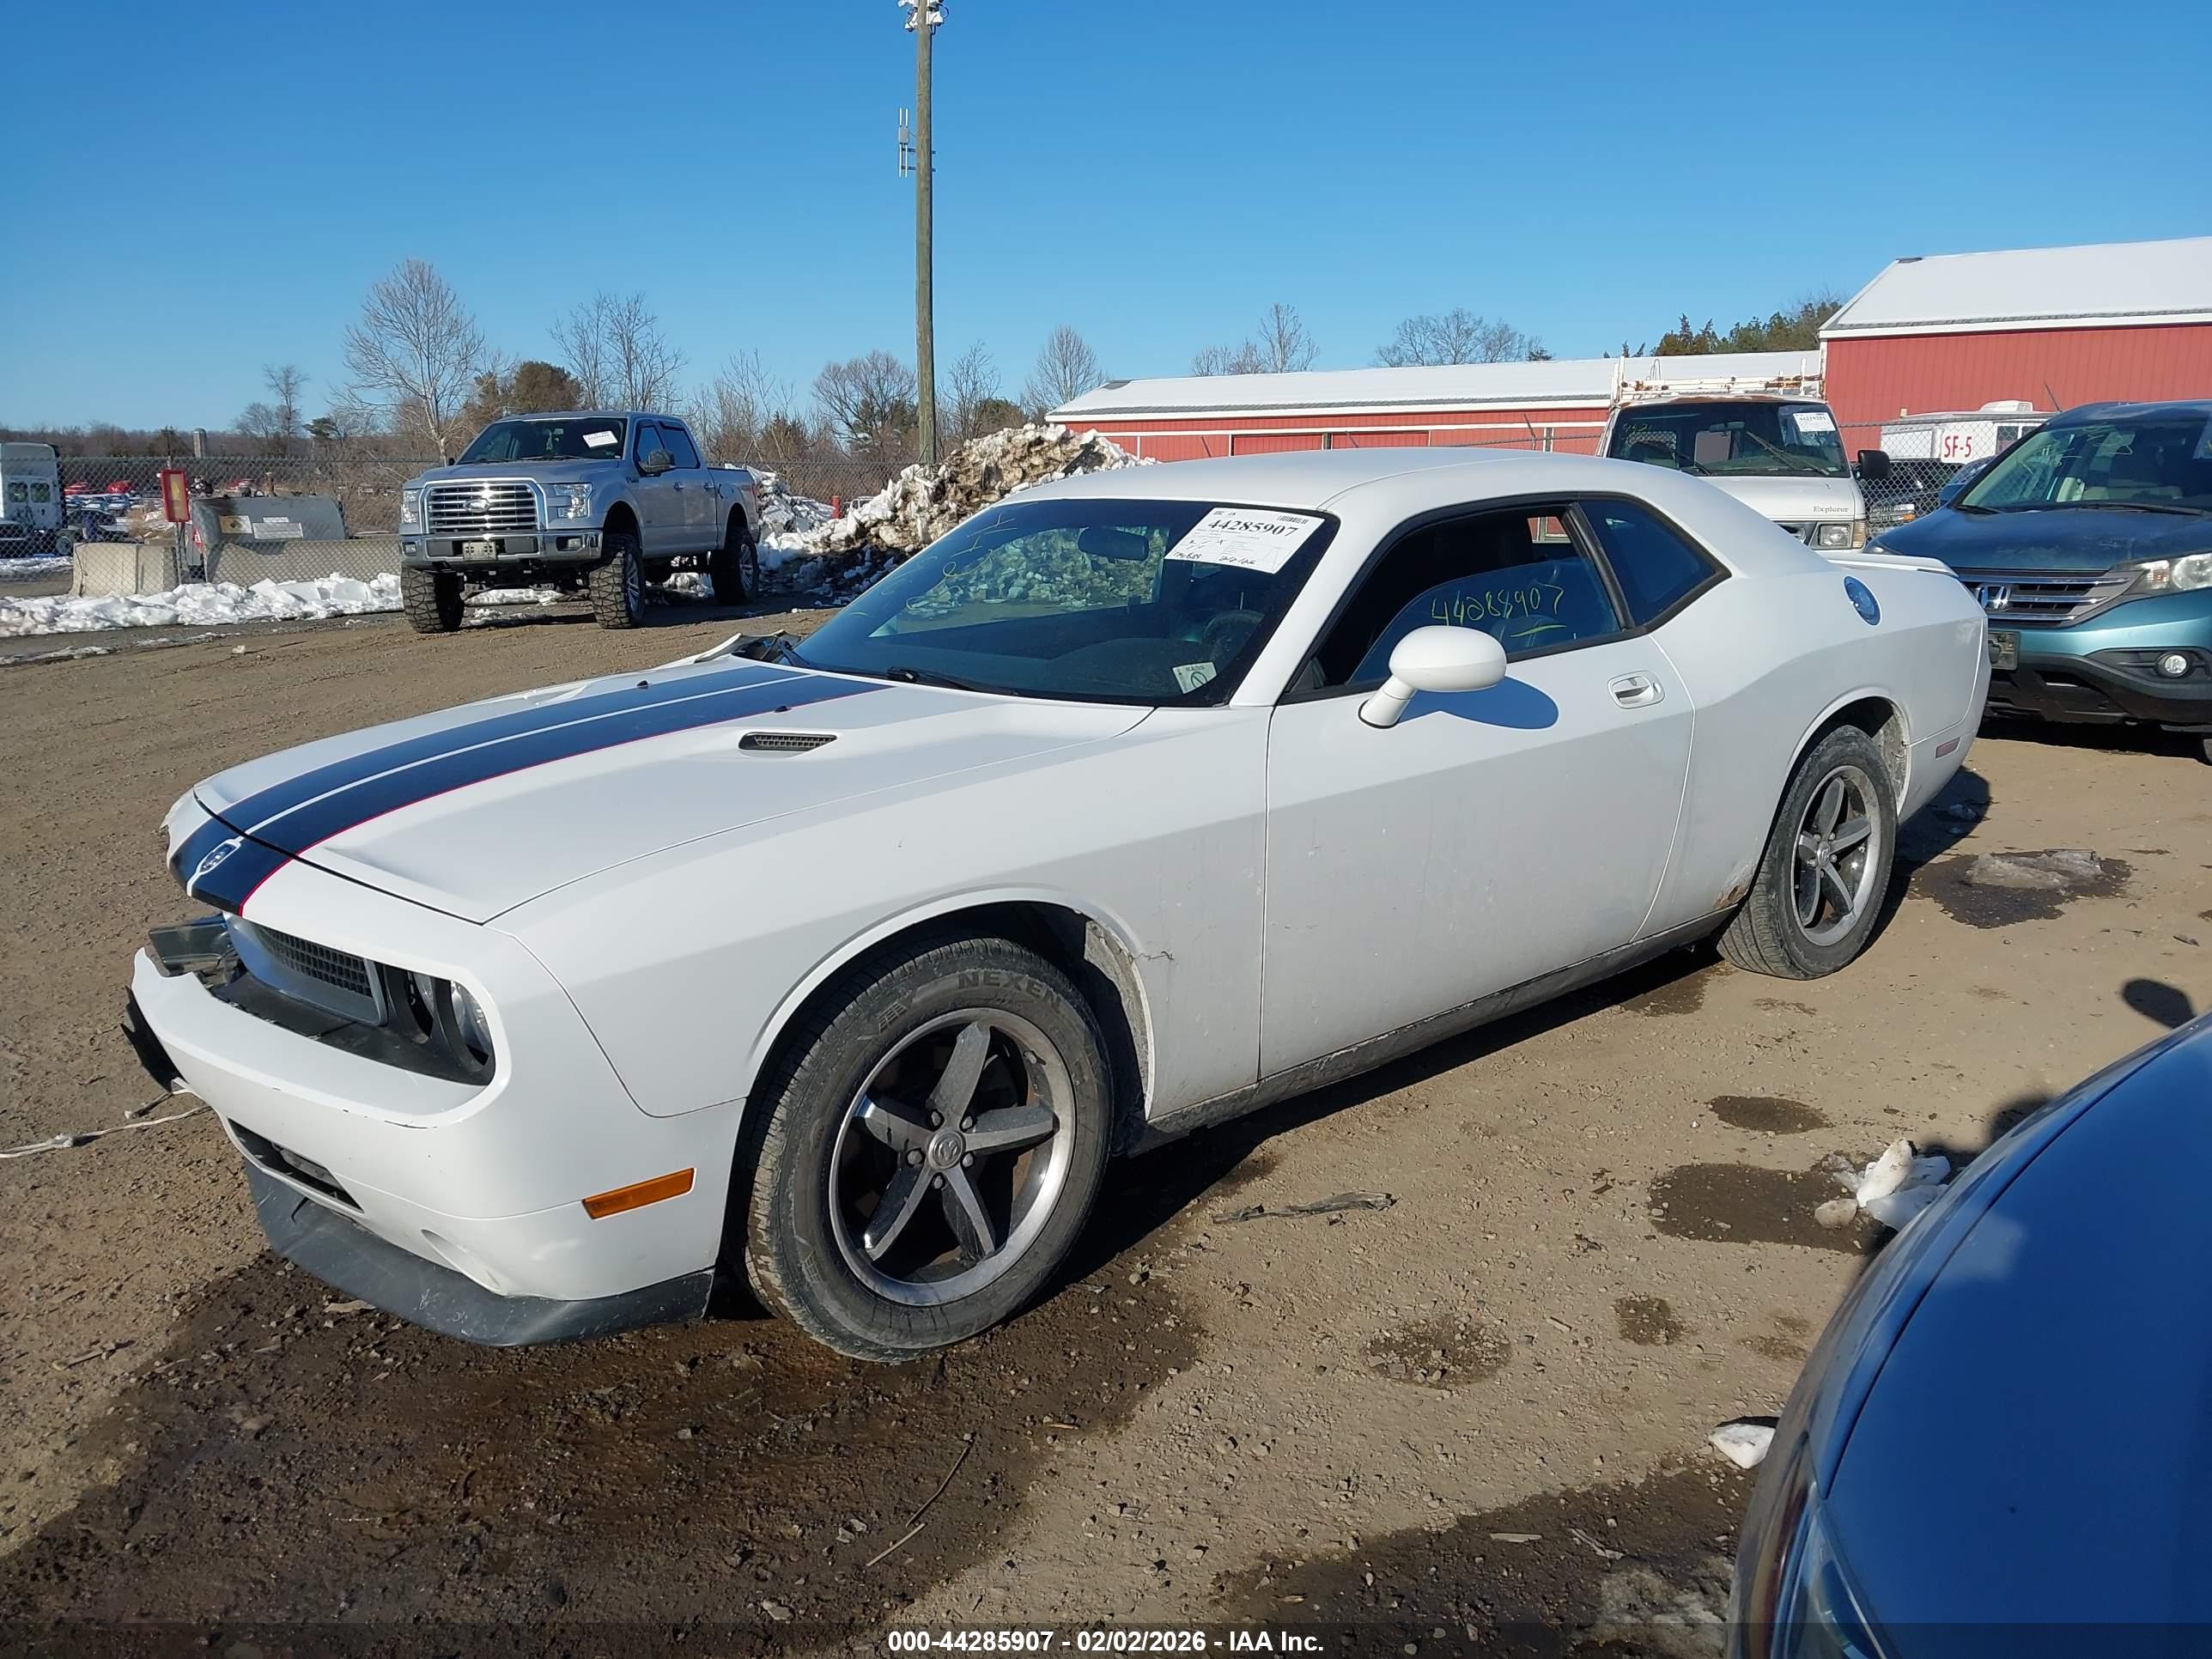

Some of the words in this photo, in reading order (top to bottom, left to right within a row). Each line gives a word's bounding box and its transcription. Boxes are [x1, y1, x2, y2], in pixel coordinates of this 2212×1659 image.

[1943, 435, 1972, 458] SF-5
[1208, 520, 1298, 537] 44285907
[958, 970, 1060, 1009] NEXEN
